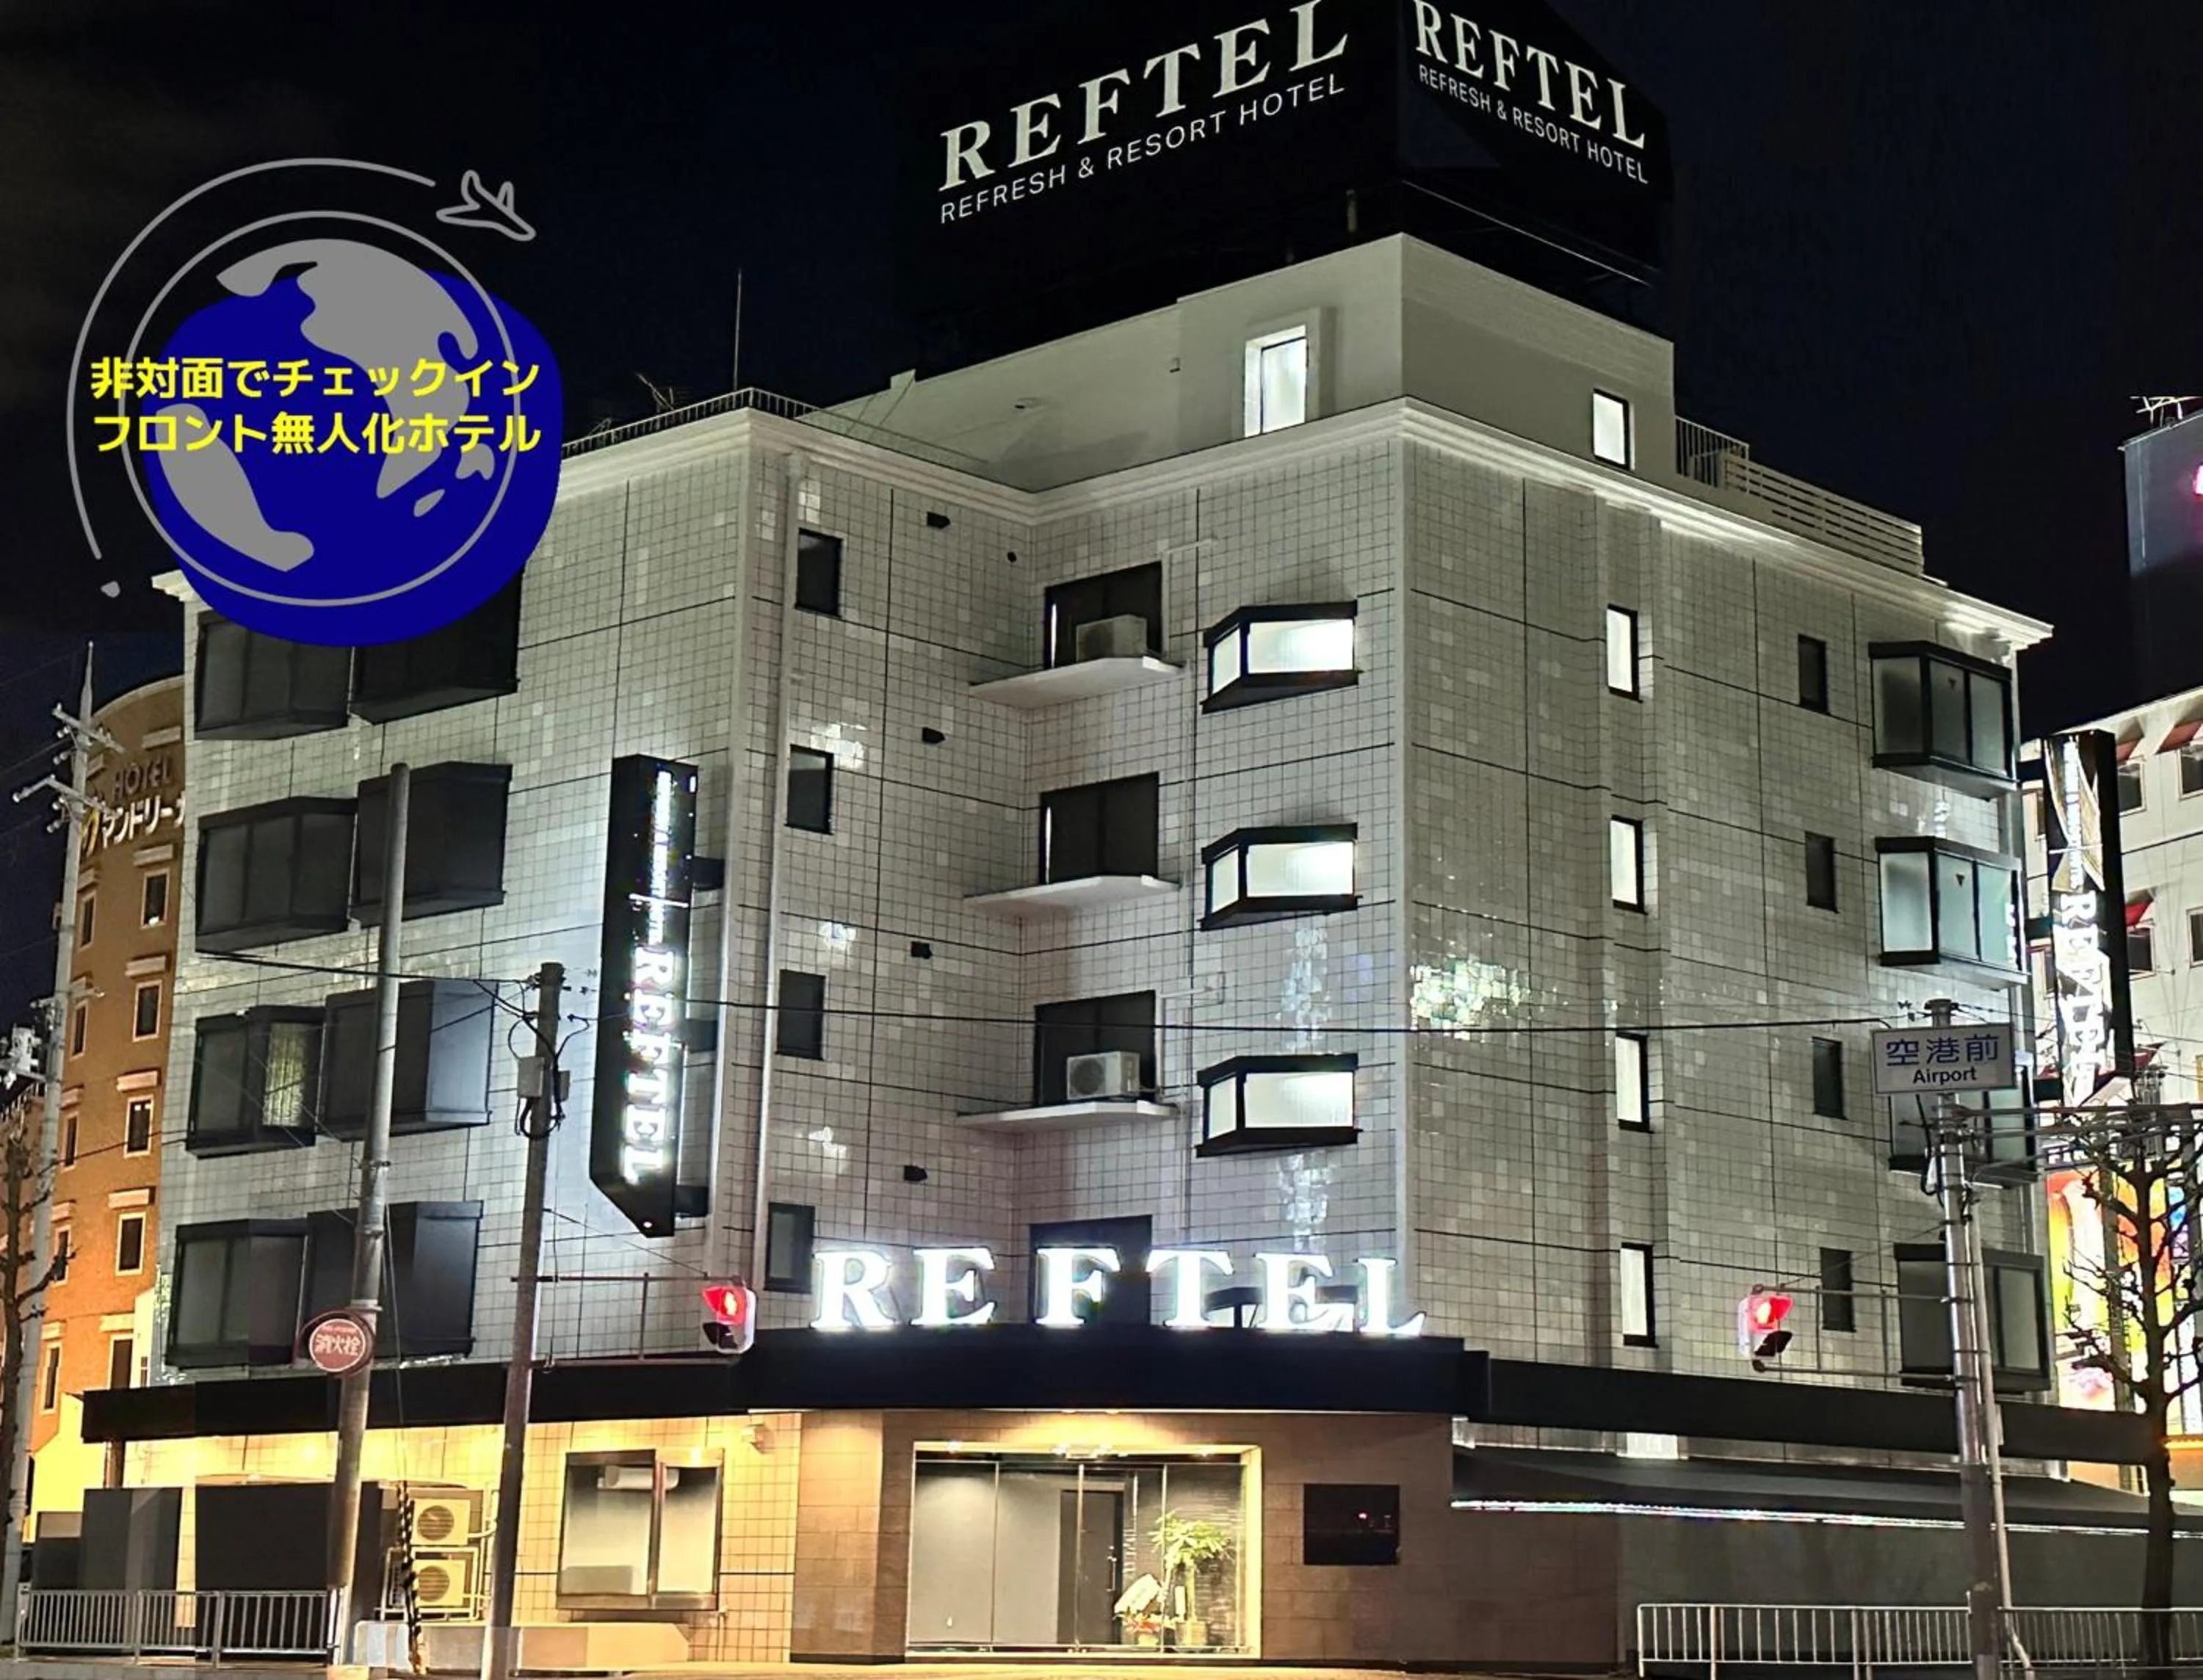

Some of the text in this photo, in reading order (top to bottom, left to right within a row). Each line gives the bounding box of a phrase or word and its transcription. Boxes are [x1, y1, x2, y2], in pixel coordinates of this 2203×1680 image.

[938, 0, 1348, 192] REFTEL
[1413, 0, 1645, 150] REFTEL
[1418, 63, 1649, 184] REFRESH & RESORT HOTEL
[940, 73, 1345, 224] REFRESH & RESORT HOTEL
[112, 753, 172, 802] HOTEL
[623, 946, 676, 1185] REFTEL
[1885, 1033, 2000, 1067] 空港前
[1912, 1066, 1978, 1085] Airport
[314, 1334, 361, 1356] 消火栓
[809, 1245, 1427, 1338] REFTEL
